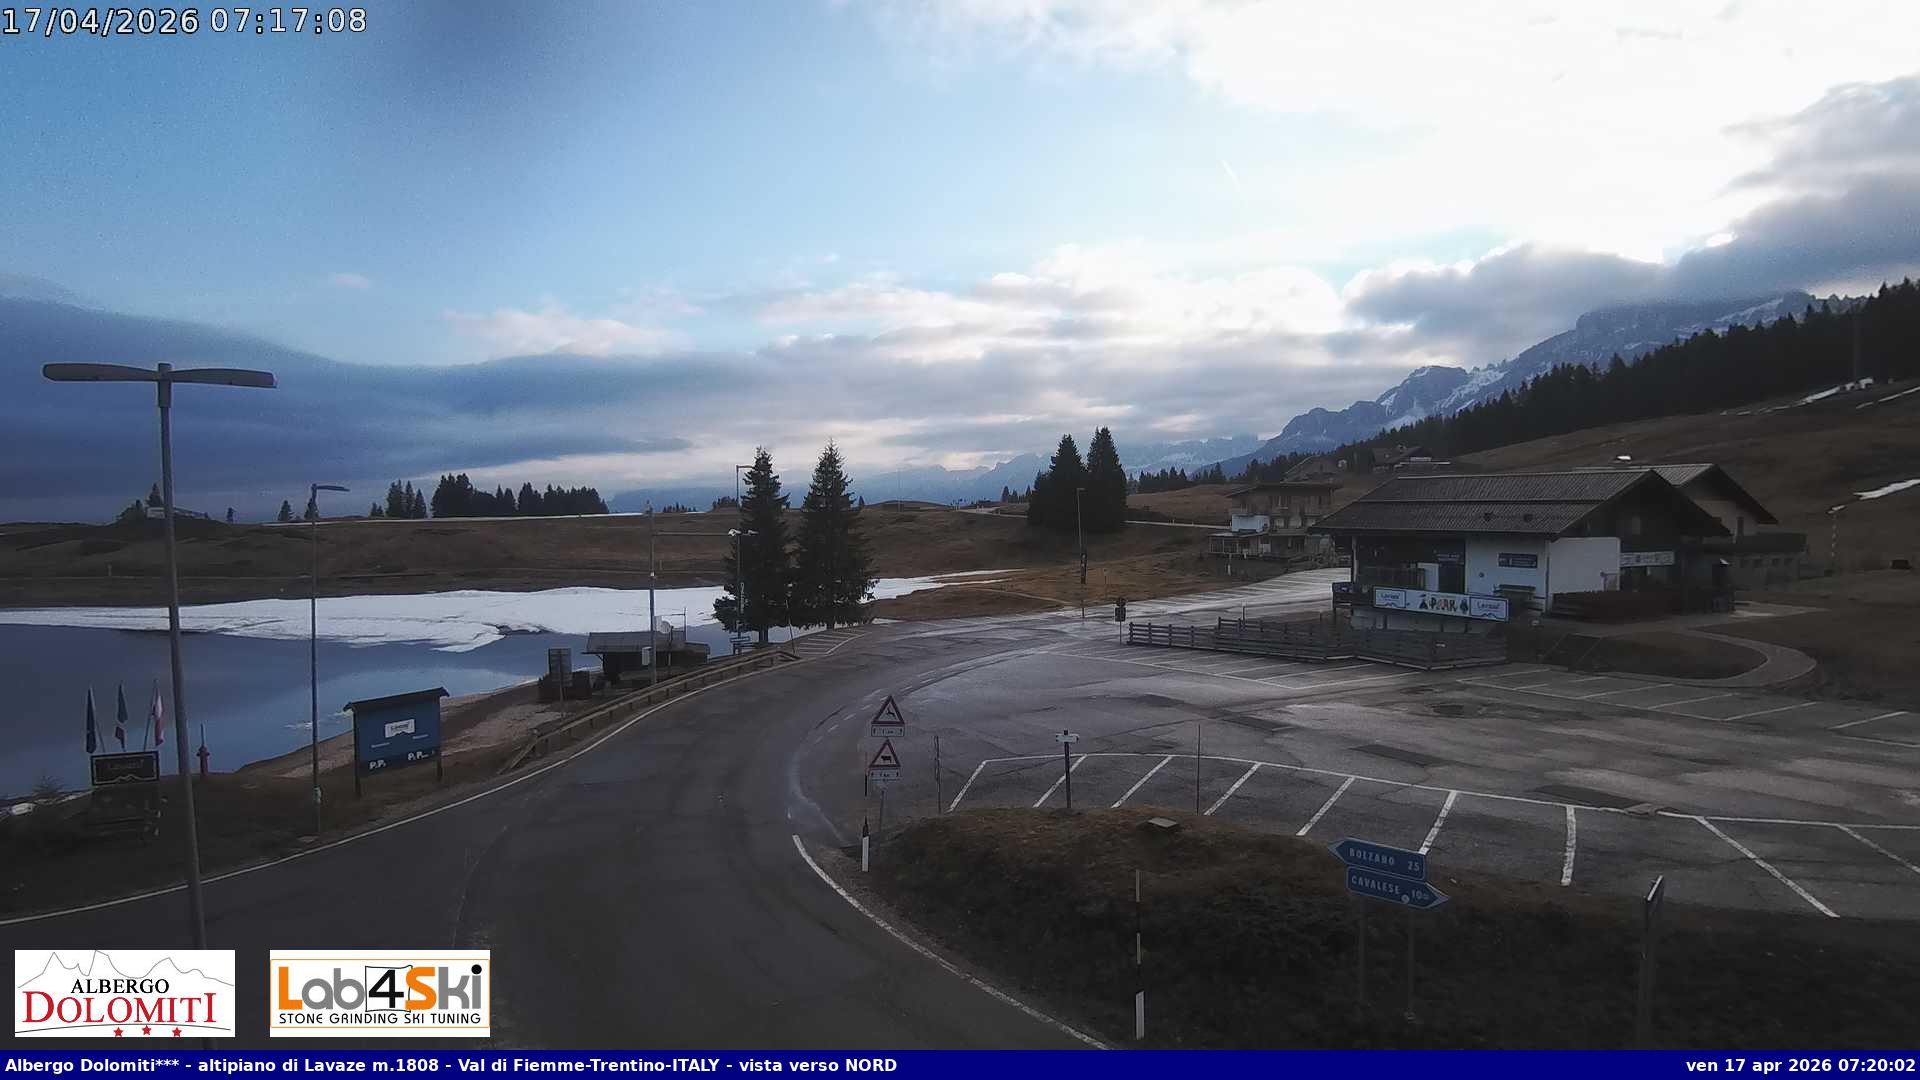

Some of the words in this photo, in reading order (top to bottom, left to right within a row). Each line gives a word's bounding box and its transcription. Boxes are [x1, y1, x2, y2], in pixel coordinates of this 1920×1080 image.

[1349, 847, 1395, 866] BOLZANO
[1407, 860, 1421, 871] 25
[1351, 875, 1400, 895] CAVALESE
